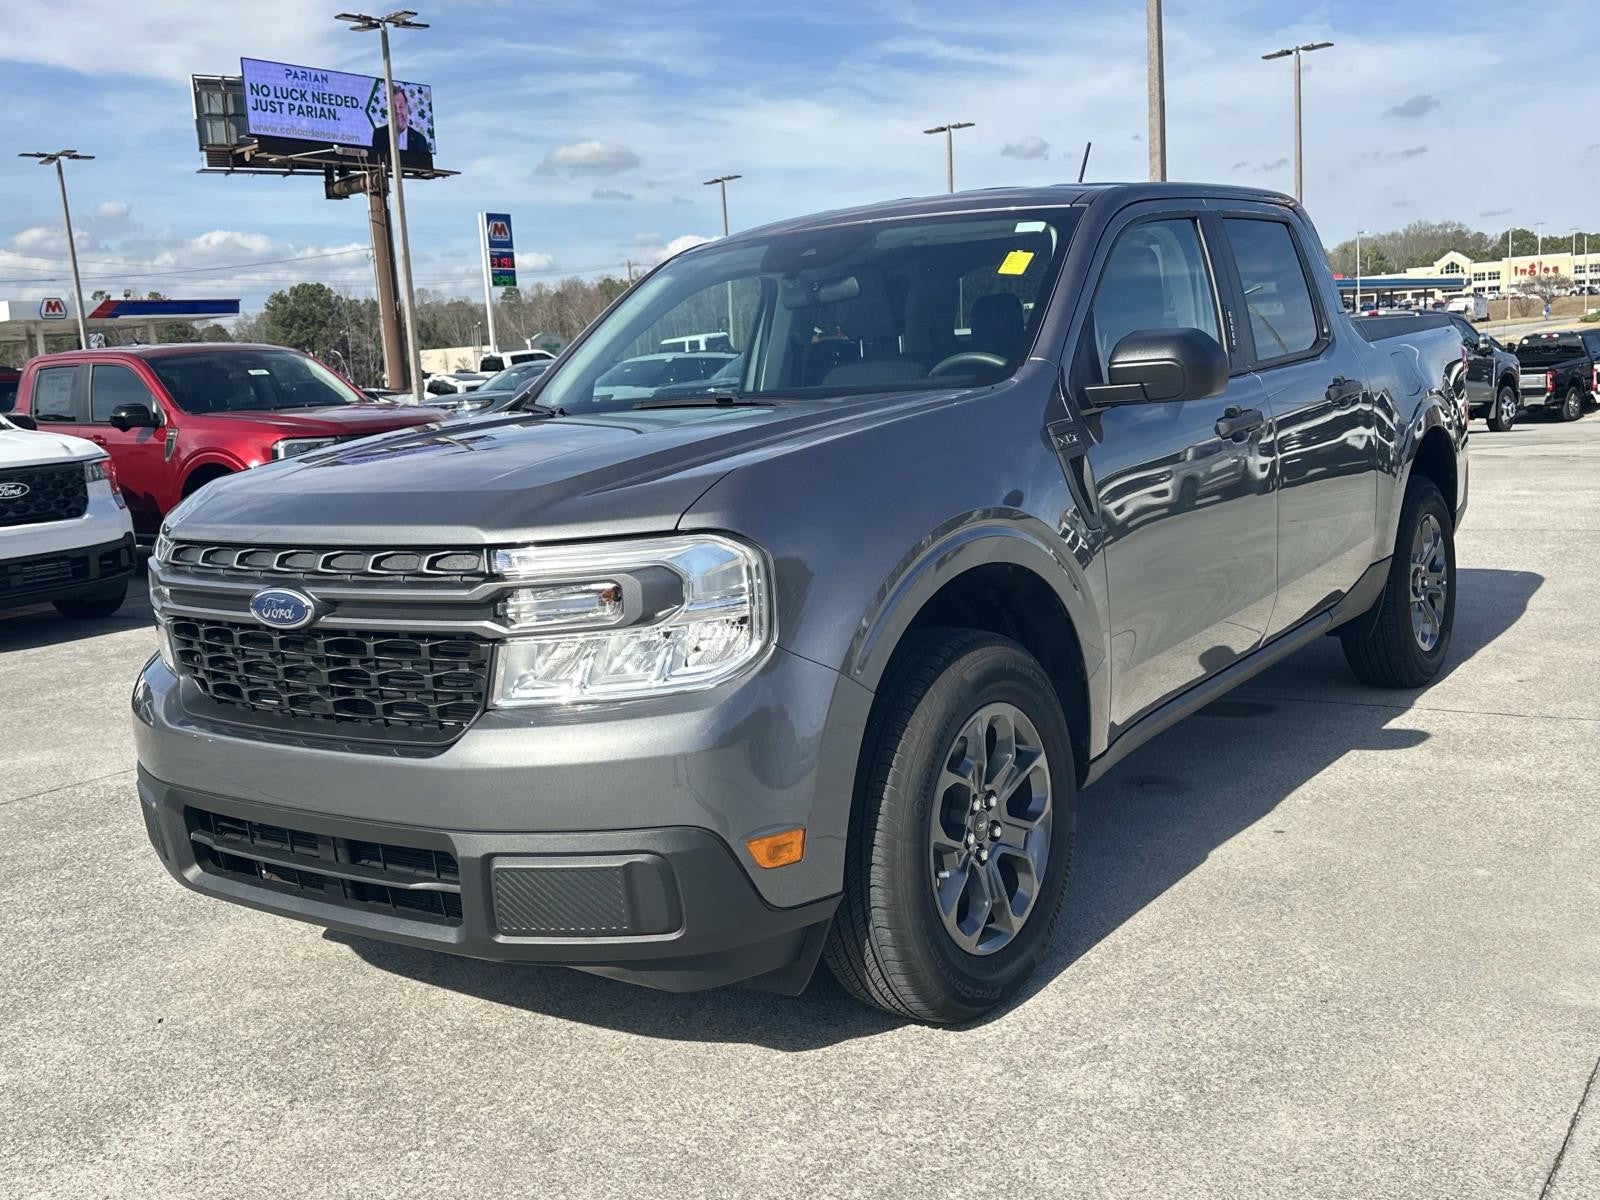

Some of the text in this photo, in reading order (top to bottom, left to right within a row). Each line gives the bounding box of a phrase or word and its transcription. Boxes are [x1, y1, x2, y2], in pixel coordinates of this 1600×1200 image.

[285, 68, 329, 84] PARIAN
[249, 82, 363, 110] NO LUCK NEEDED.
[251, 98, 341, 121] JUST PARIAN.
[262, 597, 295, 620] Ford
